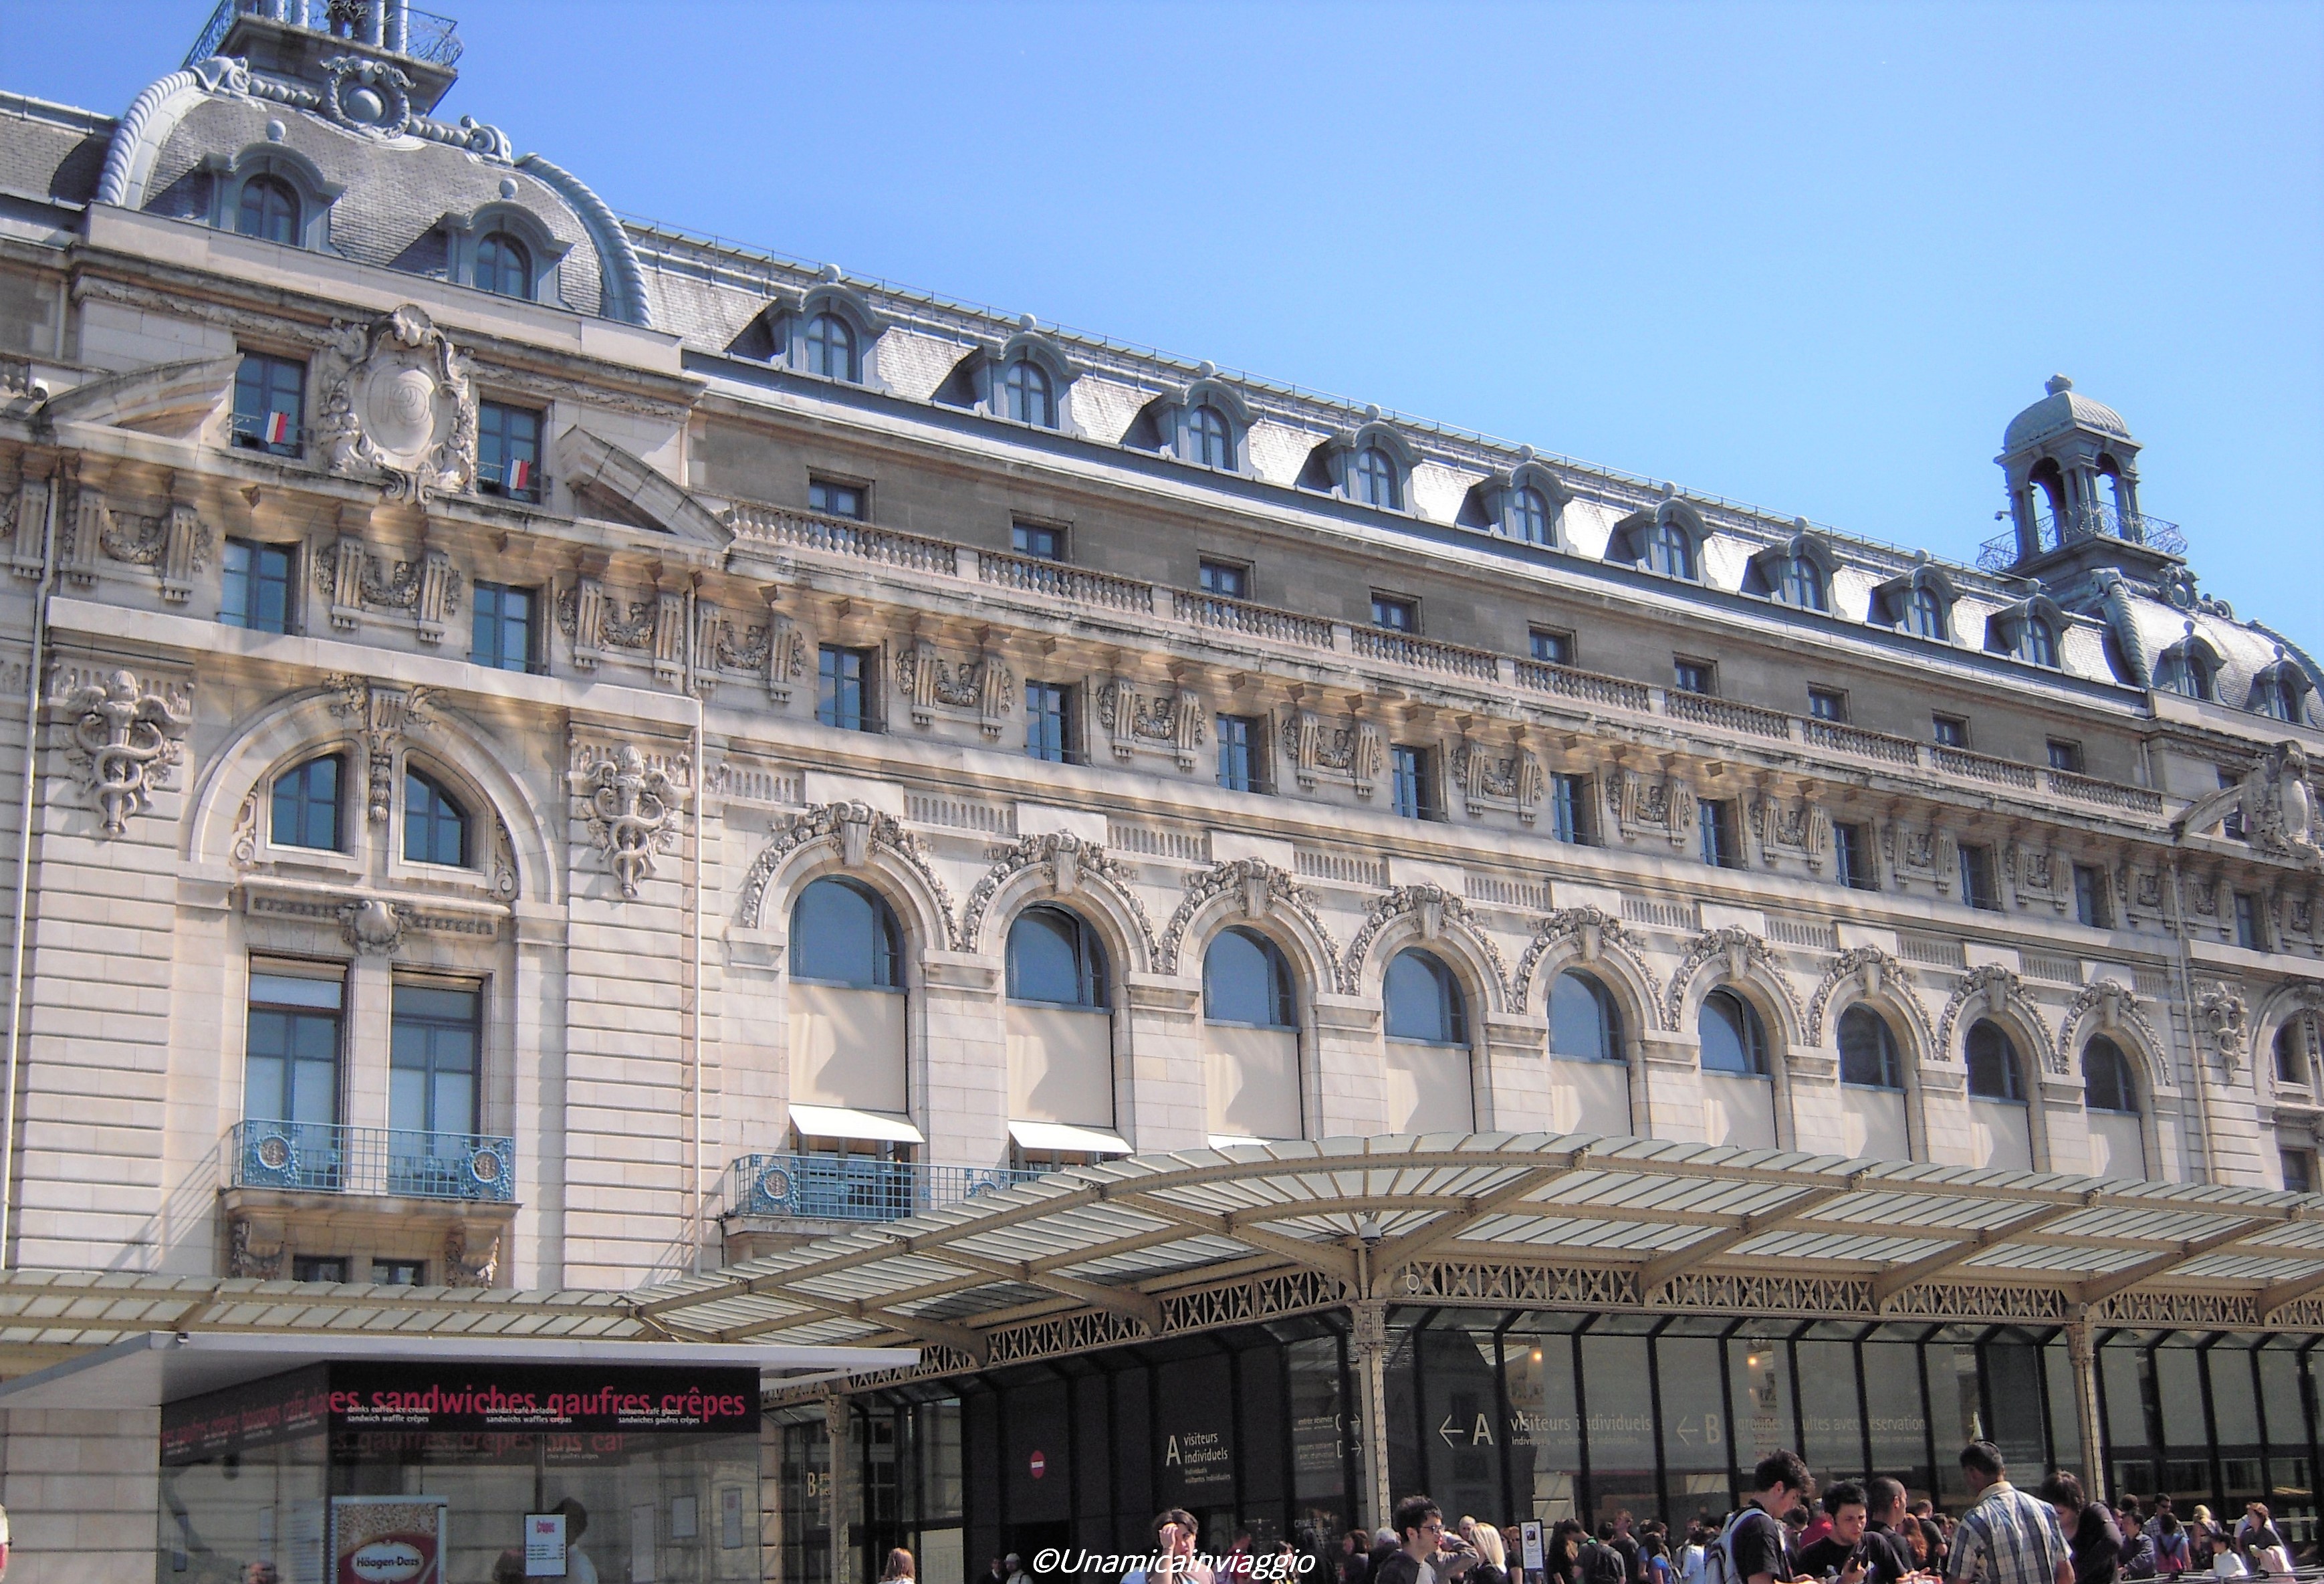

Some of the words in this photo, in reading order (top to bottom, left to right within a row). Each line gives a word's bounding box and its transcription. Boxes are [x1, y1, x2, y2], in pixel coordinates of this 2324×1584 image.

[348, 1405, 370, 1413] drinks
[371, 1405, 394, 1413] coffee
[396, 1405, 406, 1413] ice
[372, 1384, 536, 1413] sandwiches
[548, 1385, 651, 1419] gaufres
[661, 1387, 745, 1423] crêpes
[513, 1406, 530, 1414] café
[347, 1414, 380, 1422] sandwich
[382, 1414, 405, 1422] waffle
[655, 1416, 679, 1425] gaufres
[1472, 1412, 1494, 1446] A
[1510, 1412, 1571, 1432] visiteurs
[1576, 1412, 1652, 1432] idividuels
[1705, 1413, 1722, 1444] B
[1183, 1432, 1219, 1446] visiteurs
[1166, 1434, 1181, 1466] A
[1185, 1447, 1228, 1464] individuels
[808, 1472, 816, 1498] B
